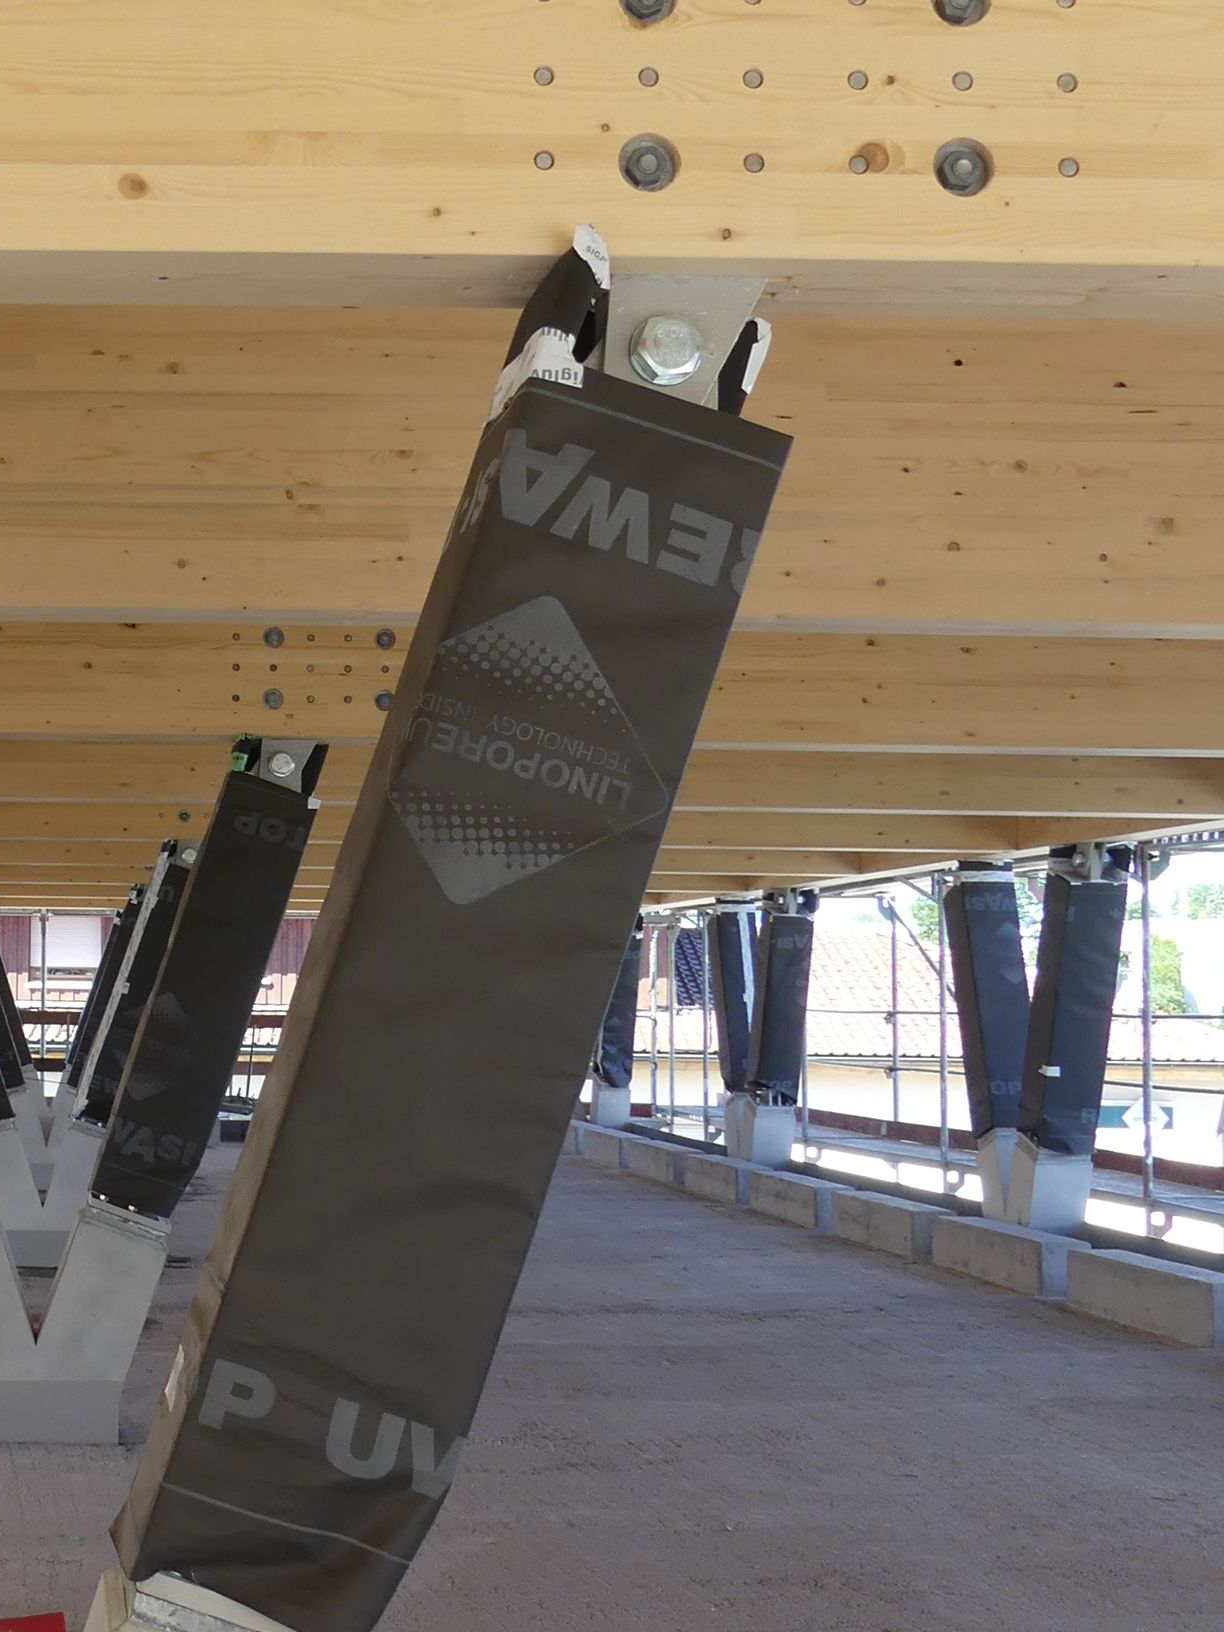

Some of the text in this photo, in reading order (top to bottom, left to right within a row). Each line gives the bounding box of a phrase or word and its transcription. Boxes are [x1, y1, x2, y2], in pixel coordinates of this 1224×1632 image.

[485, 713, 631, 773] TECHNOLOGY
[198, 1358, 468, 1500] P UV
